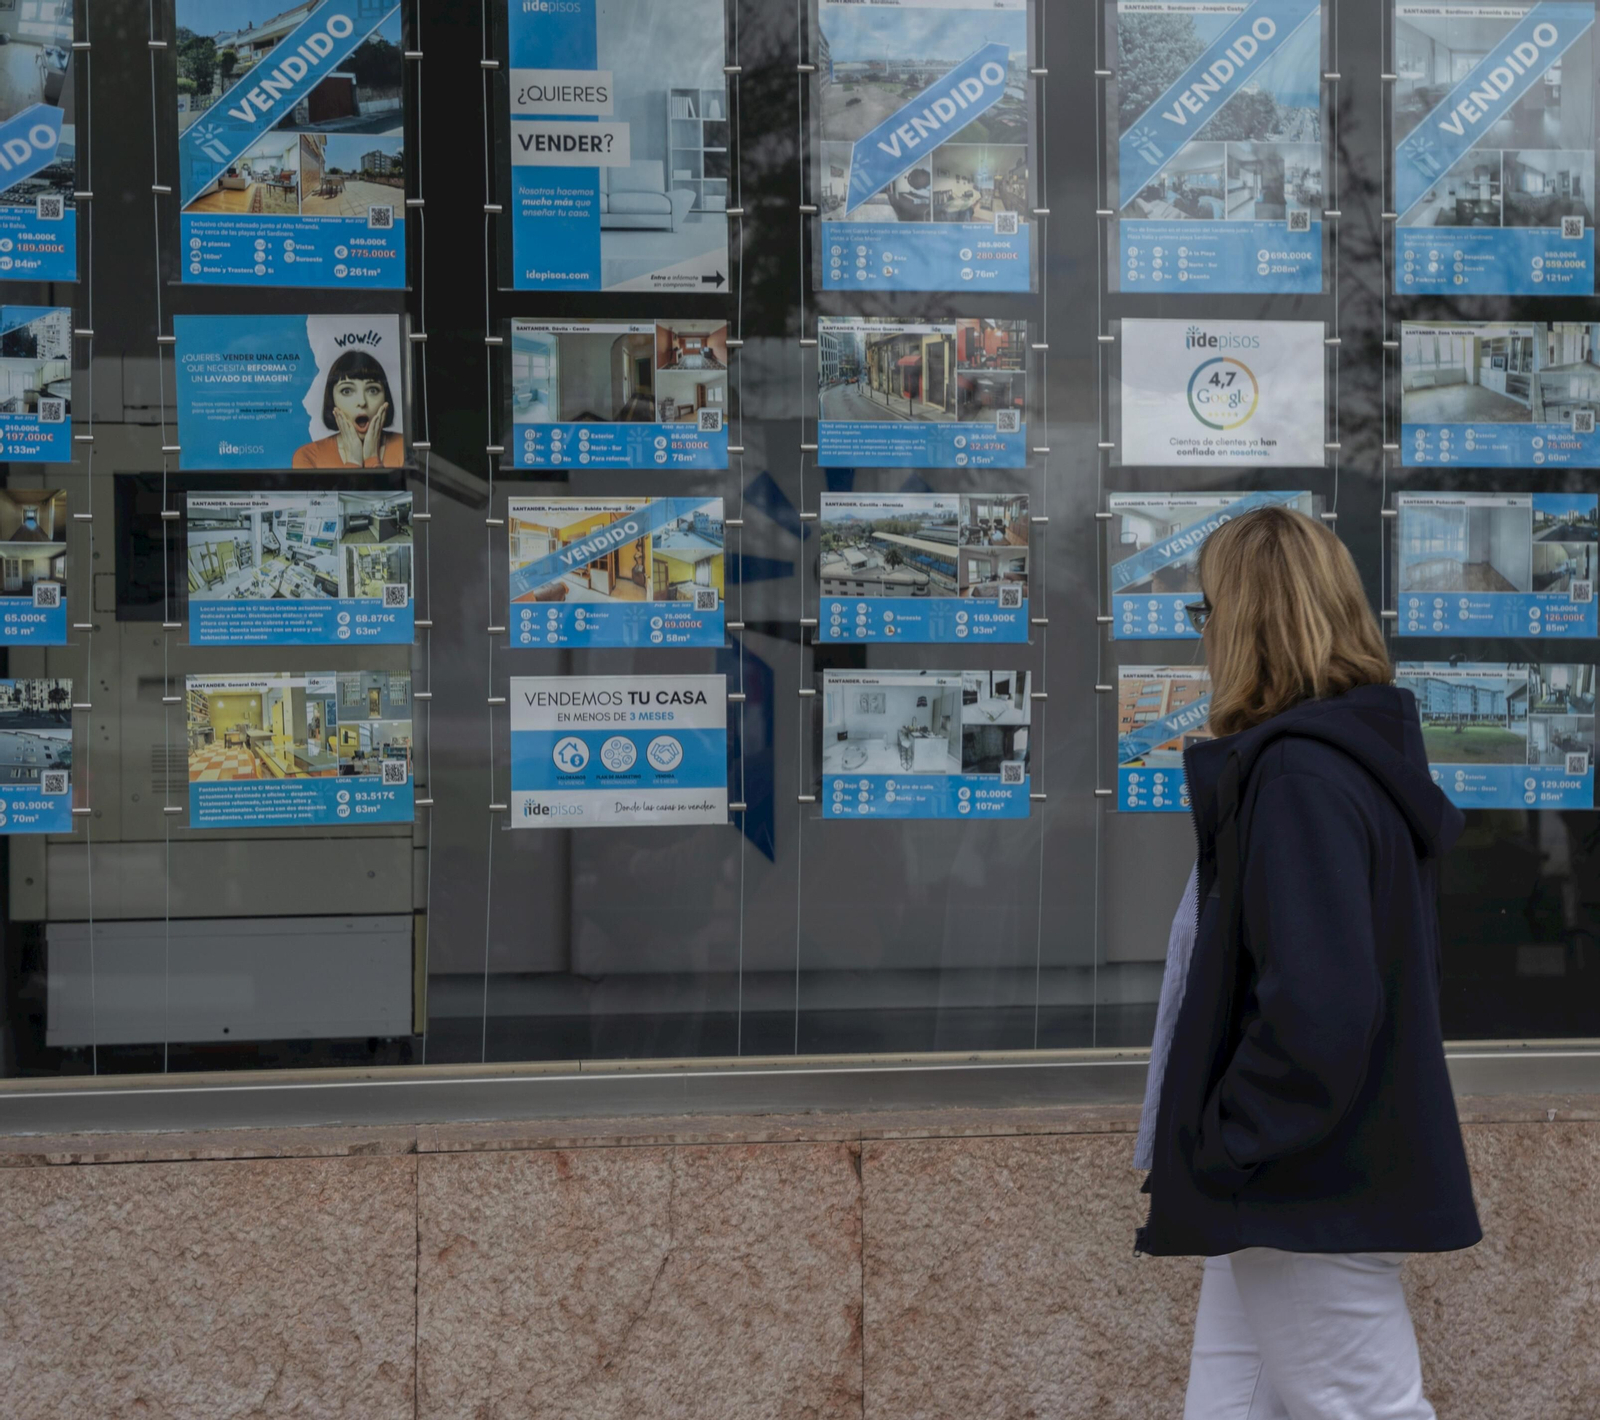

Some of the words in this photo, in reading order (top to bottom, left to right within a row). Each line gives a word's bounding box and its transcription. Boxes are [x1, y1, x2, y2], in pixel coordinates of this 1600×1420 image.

[228, 14, 354, 123] VENDIDO
[1161, 17, 1276, 125] VENDIDO
[1438, 23, 1558, 136] VENDIDO
[517, 85, 608, 105] ¿QUIERES
[877, 62, 1005, 158] VENDIDO
[517, 133, 614, 153] VENDER?
[519, 187, 555, 195] Nosotros
[556, 188, 594, 196] hacemos
[522, 198, 553, 206] mucho
[554, 198, 573, 206] más
[575, 200, 591, 208] que
[523, 208, 556, 216] enseñar
[557, 208, 566, 216] tu
[191, 220, 217, 228] Exclusivo
[217, 220, 235, 228] chalet
[349, 237, 387, 246] 849.000€
[17, 243, 65, 253] 189.900€
[350, 248, 396, 259] 775.000€
[1270, 251, 1313, 260] 690.000€
[15, 259, 41, 270] 84m²
[349, 267, 381, 277] 261m²
[526, 270, 589, 282] idepisos.com
[334, 329, 383, 349] WOW!!!
[181, 353, 221, 363] ¿QUIERES
[222, 353, 255, 361] VENDER
[256, 353, 275, 361] UNA
[275, 353, 300, 361] CASA
[186, 364, 205, 372] QUE
[206, 364, 246, 372] NECESITA
[247, 364, 288, 372] REFORMA
[191, 375, 203, 383] UN
[205, 374, 240, 382] LAVADO
[241, 374, 252, 382] DE
[254, 374, 293, 383] IMAGEN?
[1208, 372, 1238, 389] 4,7
[1196, 388, 1249, 408] Google
[6, 432, 54, 443] 197.000€
[1169, 437, 1202, 447] Cientos
[1203, 437, 1214, 446] de
[1214, 438, 1247, 447] clientes
[1248, 439, 1259, 449] ya
[1260, 438, 1278, 447] han
[7, 445, 41, 455] 133m²
[1176, 447, 1215, 457] confiado
[1217, 449, 1228, 457] en
[1229, 448, 1270, 457] nosotros.
[672, 453, 697, 463] 78m²
[559, 521, 639, 566] VENDIDO
[4, 613, 47, 623] 65.000€
[355, 613, 396, 624] 68.876€
[5, 626, 18, 635] 65
[355, 627, 381, 636] 63m²
[972, 626, 997, 635] 93m²
[524, 691, 623, 707] VENDEMOS
[628, 691, 651, 705] TU
[655, 690, 707, 705] CASA
[557, 712, 571, 722] EN
[573, 712, 611, 722] MENOS
[613, 712, 627, 721] DE
[629, 712, 636, 721] 3
[638, 711, 675, 721] MESES
[355, 791, 395, 802] 93.517€
[974, 789, 1013, 798] 80.000€
[12, 801, 54, 810] 69.900€
[355, 804, 381, 814] 63m²
[614, 802, 641, 814] Donde
[642, 801, 655, 811] las
[687, 800, 717, 811] venden
[975, 801, 1005, 811] 107m²
[12, 813, 39, 823] 70m²
